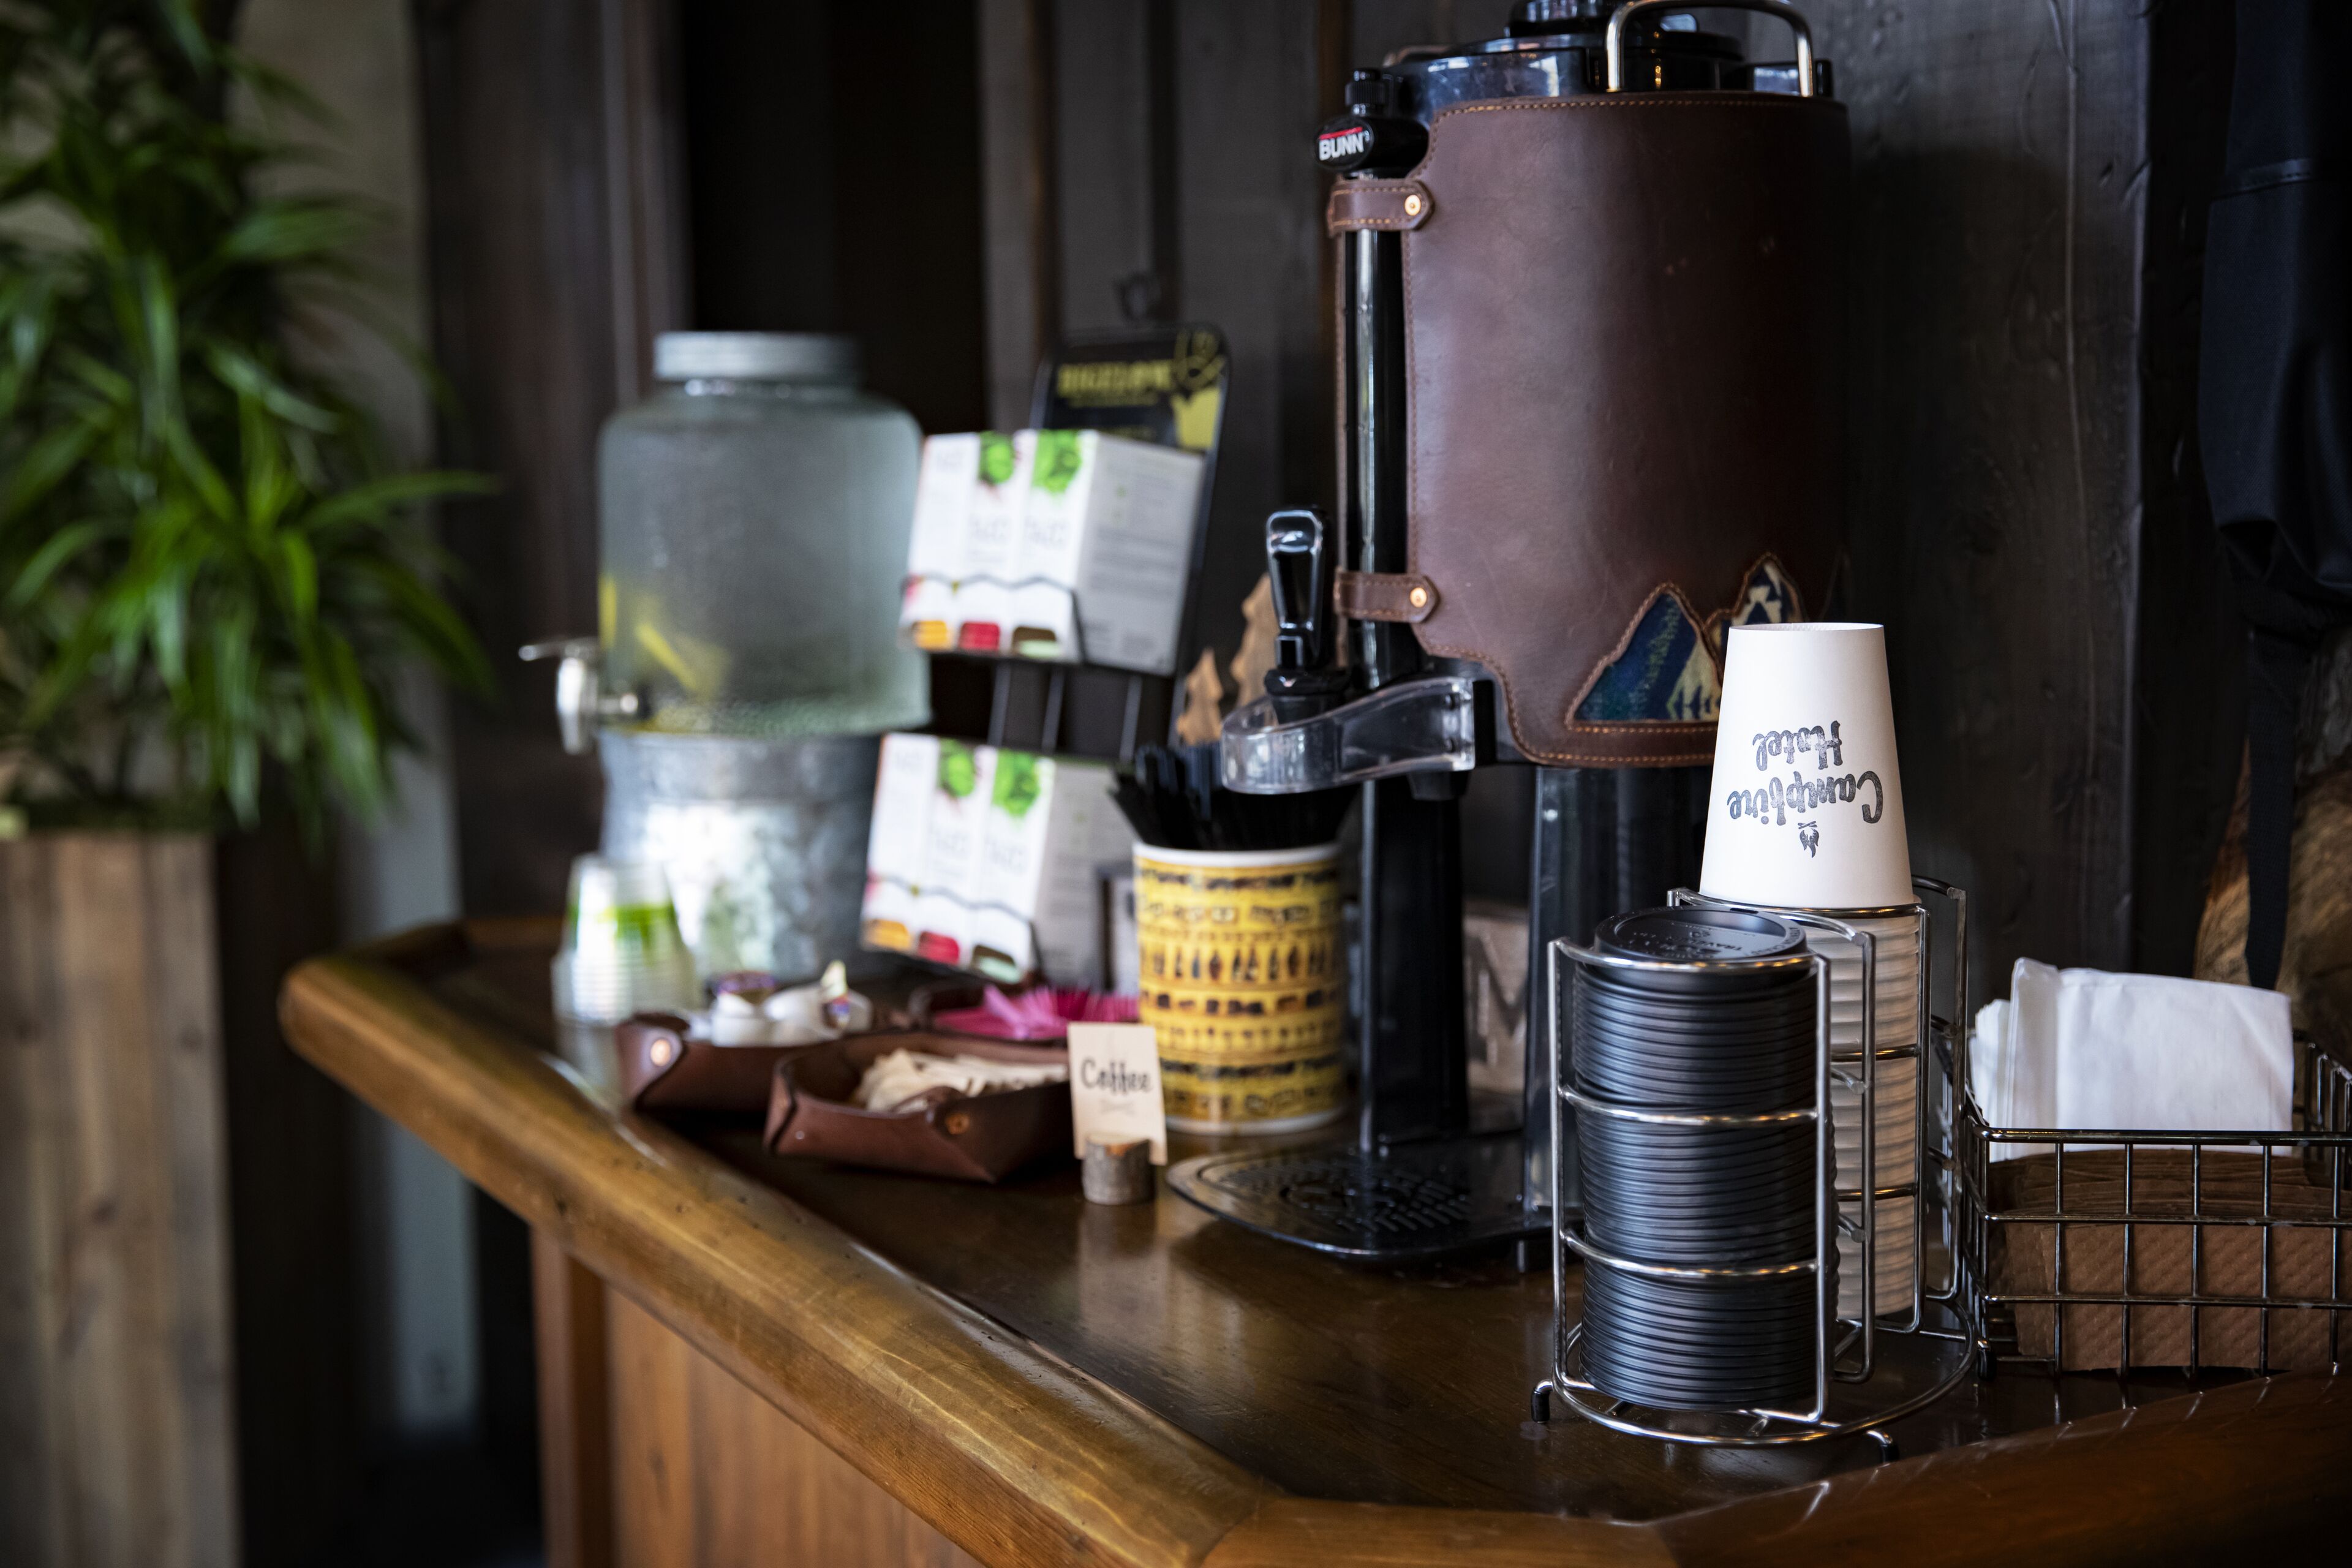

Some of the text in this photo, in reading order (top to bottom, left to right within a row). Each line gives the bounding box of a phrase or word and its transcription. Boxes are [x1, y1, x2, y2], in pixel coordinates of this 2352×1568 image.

[1752, 720, 1843, 771] Hotel
[1727, 771, 1883, 826] Campfire
[1080, 1057, 1152, 1095] Coffee
